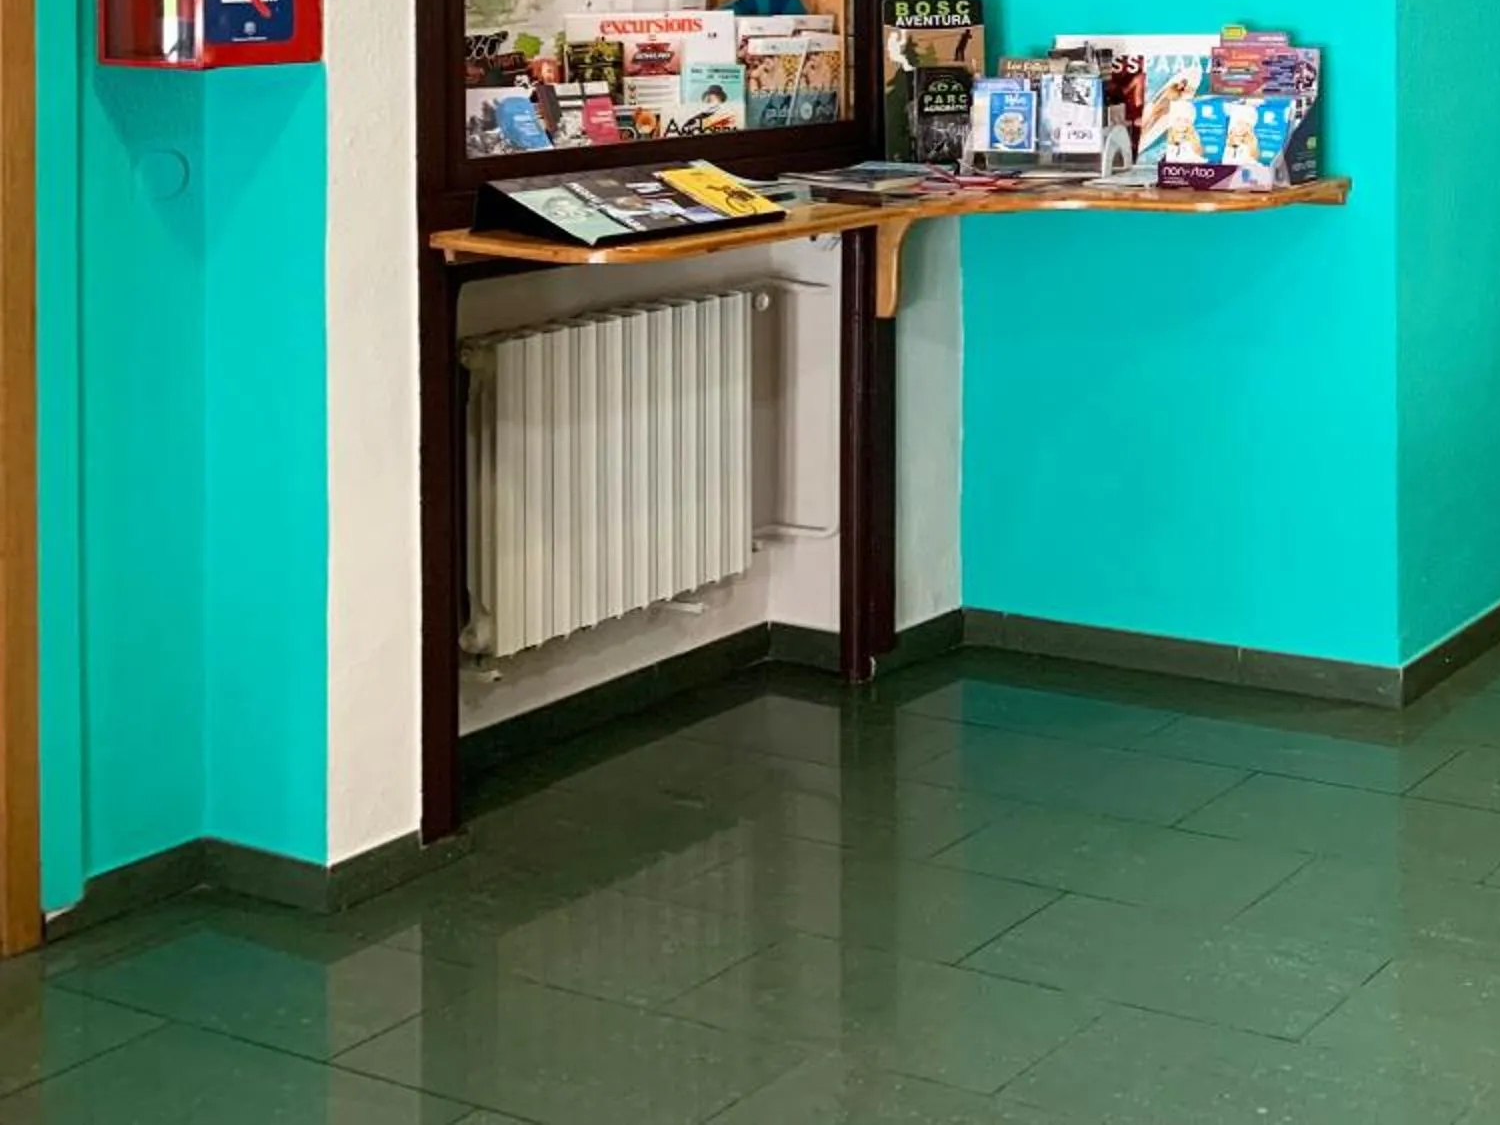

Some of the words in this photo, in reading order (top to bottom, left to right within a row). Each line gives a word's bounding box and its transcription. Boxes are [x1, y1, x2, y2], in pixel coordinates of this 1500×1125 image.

[895, 0, 970, 16] BOSC
[600, 18, 703, 34] excursions
[896, 15, 971, 26] AVENTURA
[924, 94, 967, 105] PARC
[1163, 166, 1214, 179] non-stop
